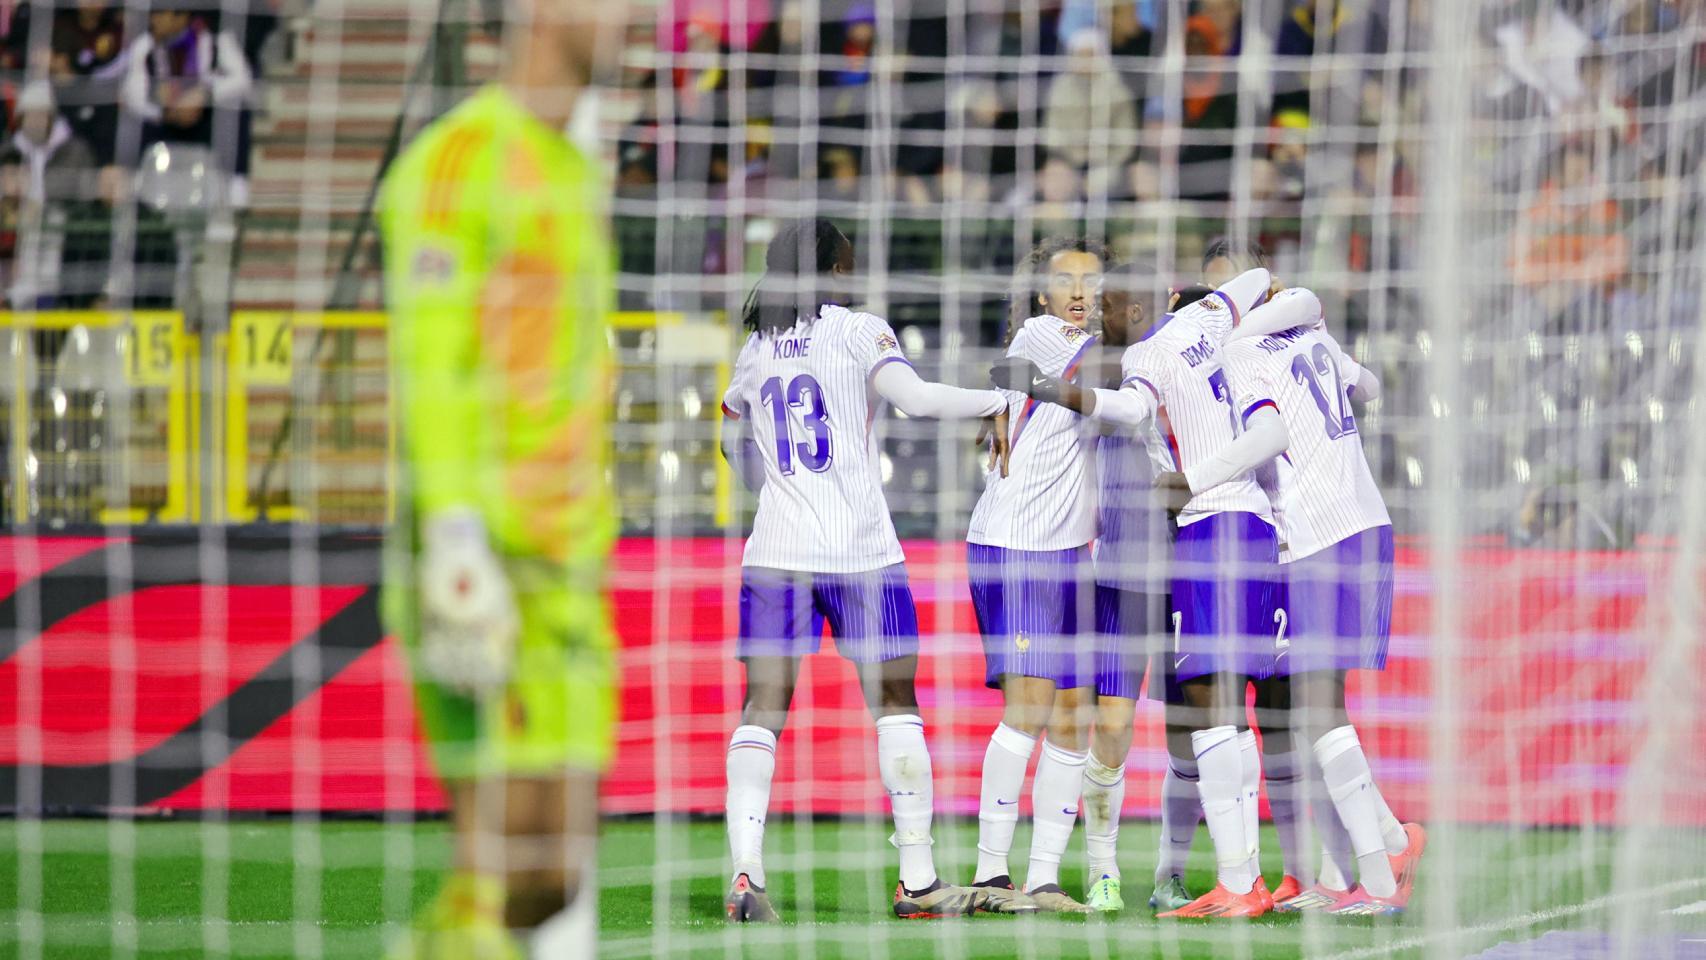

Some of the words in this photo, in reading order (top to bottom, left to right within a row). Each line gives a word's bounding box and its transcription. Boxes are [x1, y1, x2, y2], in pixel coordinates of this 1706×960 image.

[130, 324, 173, 375] 15
[246, 322, 290, 369] 14
[773, 337, 812, 360] KONE
[1291, 343, 1358, 440] 12
[760, 373, 833, 477] 13
[1273, 608, 1290, 649] 2
